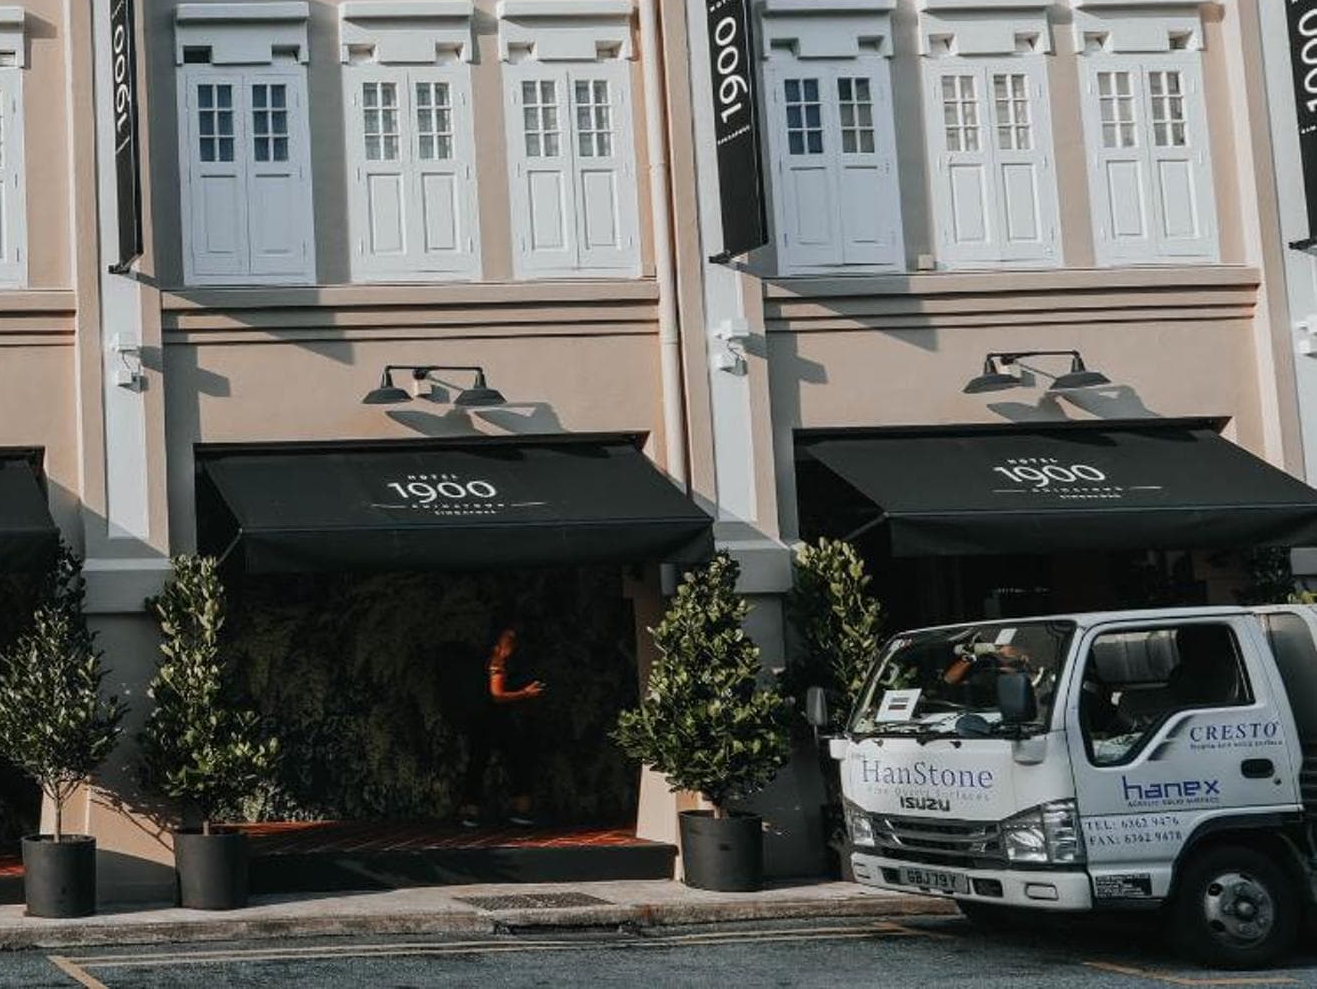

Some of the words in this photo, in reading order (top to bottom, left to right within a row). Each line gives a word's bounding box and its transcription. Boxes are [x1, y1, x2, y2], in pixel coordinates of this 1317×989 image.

[114, 24, 131, 132] 1900
[715, 16, 749, 124] 1900
[993, 464, 1106, 487] 1900
[387, 480, 497, 504] 1900
[1190, 722, 1277, 742] CRESTO
[862, 760, 994, 789] HanStone
[1122, 775, 1220, 800] hanex
[900, 796, 951, 812] ISUZU
[1090, 835, 1120, 845] FAX:
